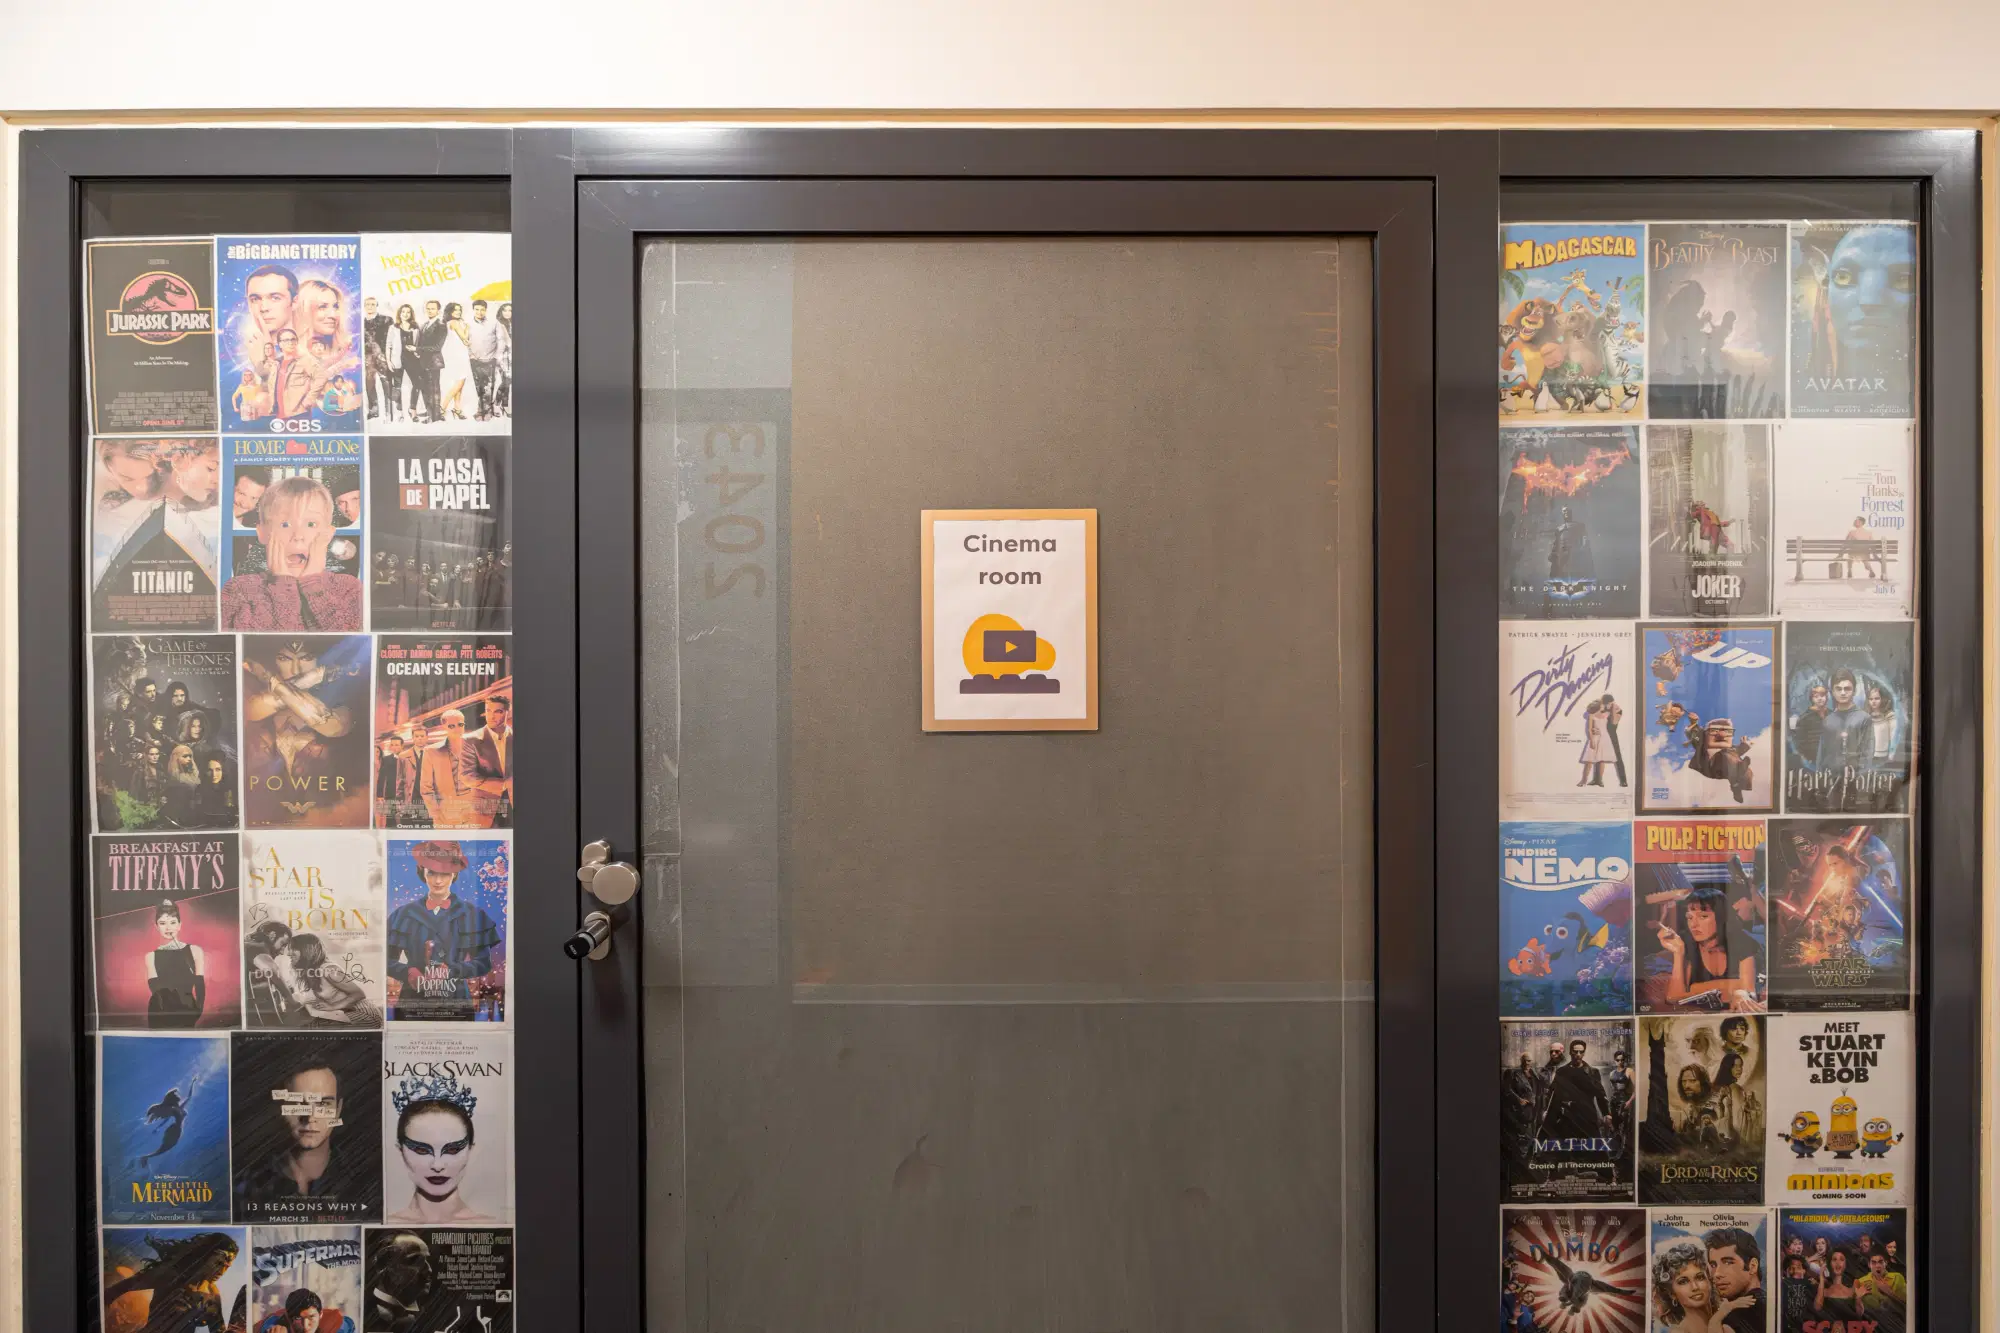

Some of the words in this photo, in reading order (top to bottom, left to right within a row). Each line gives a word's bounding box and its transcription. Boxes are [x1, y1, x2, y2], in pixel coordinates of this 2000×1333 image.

[300, 244, 357, 259] THEORY
[1504, 235, 1637, 270] MADAGASCAR
[1651, 238, 1715, 271] BEAUTY
[1724, 238, 1780, 268] BEAST
[380, 252, 415, 270] how
[400, 260, 425, 275] met
[428, 252, 456, 268] your
[387, 264, 462, 296] mother
[110, 313, 169, 333] JURASSIC
[171, 312, 210, 332] PARK
[1805, 378, 1888, 392] AVATAR
[286, 419, 322, 432] CBS
[234, 440, 286, 454] HOME
[398, 458, 424, 484] LA
[428, 458, 486, 484] CASA
[1874, 472, 1896, 485] Tom
[406, 489, 422, 506] DE
[429, 484, 490, 510] PAPEL
[1867, 484, 1898, 498] Hanks
[1861, 496, 1905, 512] Forrest
[1868, 513, 1905, 530] Gump
[964, 534, 1057, 553] Cinema
[132, 570, 194, 594] TITANIC
[979, 571, 1042, 585] room
[1692, 574, 1741, 598] JOKER
[148, 638, 194, 654] GAME
[1692, 640, 1772, 669] UP
[166, 653, 232, 667] THRONES
[387, 662, 443, 676] OCEAN'S
[446, 662, 495, 676] ELEVEN
[1510, 640, 1591, 717] Dirty
[1535, 652, 1613, 734] Dancing
[250, 776, 346, 792] POWER
[1788, 767, 1840, 800] Harry
[1841, 765, 1896, 811] Potter
[1646, 825, 1694, 852] PULP
[1696, 824, 1766, 850] FICTION
[108, 842, 200, 854] BREAKFAST
[204, 842, 224, 852] AT
[1504, 848, 1558, 856] FINDING
[264, 846, 282, 868] A
[108, 854, 225, 891] TIFFANY'S
[248, 866, 324, 889] STAR
[1504, 856, 1629, 884] NEMO
[307, 888, 336, 910] IS
[288, 908, 371, 931] BORN
[424, 965, 451, 980] MARY
[1812, 958, 1871, 971] STAR
[417, 976, 459, 993] POPPINS
[1812, 974, 1871, 987] WARS
[1824, 1022, 1860, 1034] MEET
[1798, 1034, 1886, 1051] STUART
[1807, 1051, 1878, 1068] KEVIN
[384, 1060, 440, 1080] BLACK
[443, 1060, 504, 1080] SWAN
[1534, 1138, 1613, 1152] MATRIX
[1528, 1162, 1556, 1170] Croire
[1565, 1162, 1615, 1170] l'incroyable
[1661, 1164, 1698, 1184] LORD
[1710, 1166, 1758, 1182] RINGS
[1787, 1172, 1894, 1190] minions
[132, 1182, 213, 1206] MERMAID
[247, 1203, 258, 1211] 13
[264, 1203, 322, 1211] REASONS
[328, 1203, 357, 1211] WHY
[150, 1212, 185, 1221] November
[432, 1232, 466, 1244] PARAMOUNT
[468, 1232, 494, 1244] PICTURES
[1530, 1240, 1620, 1264] DUMBO
